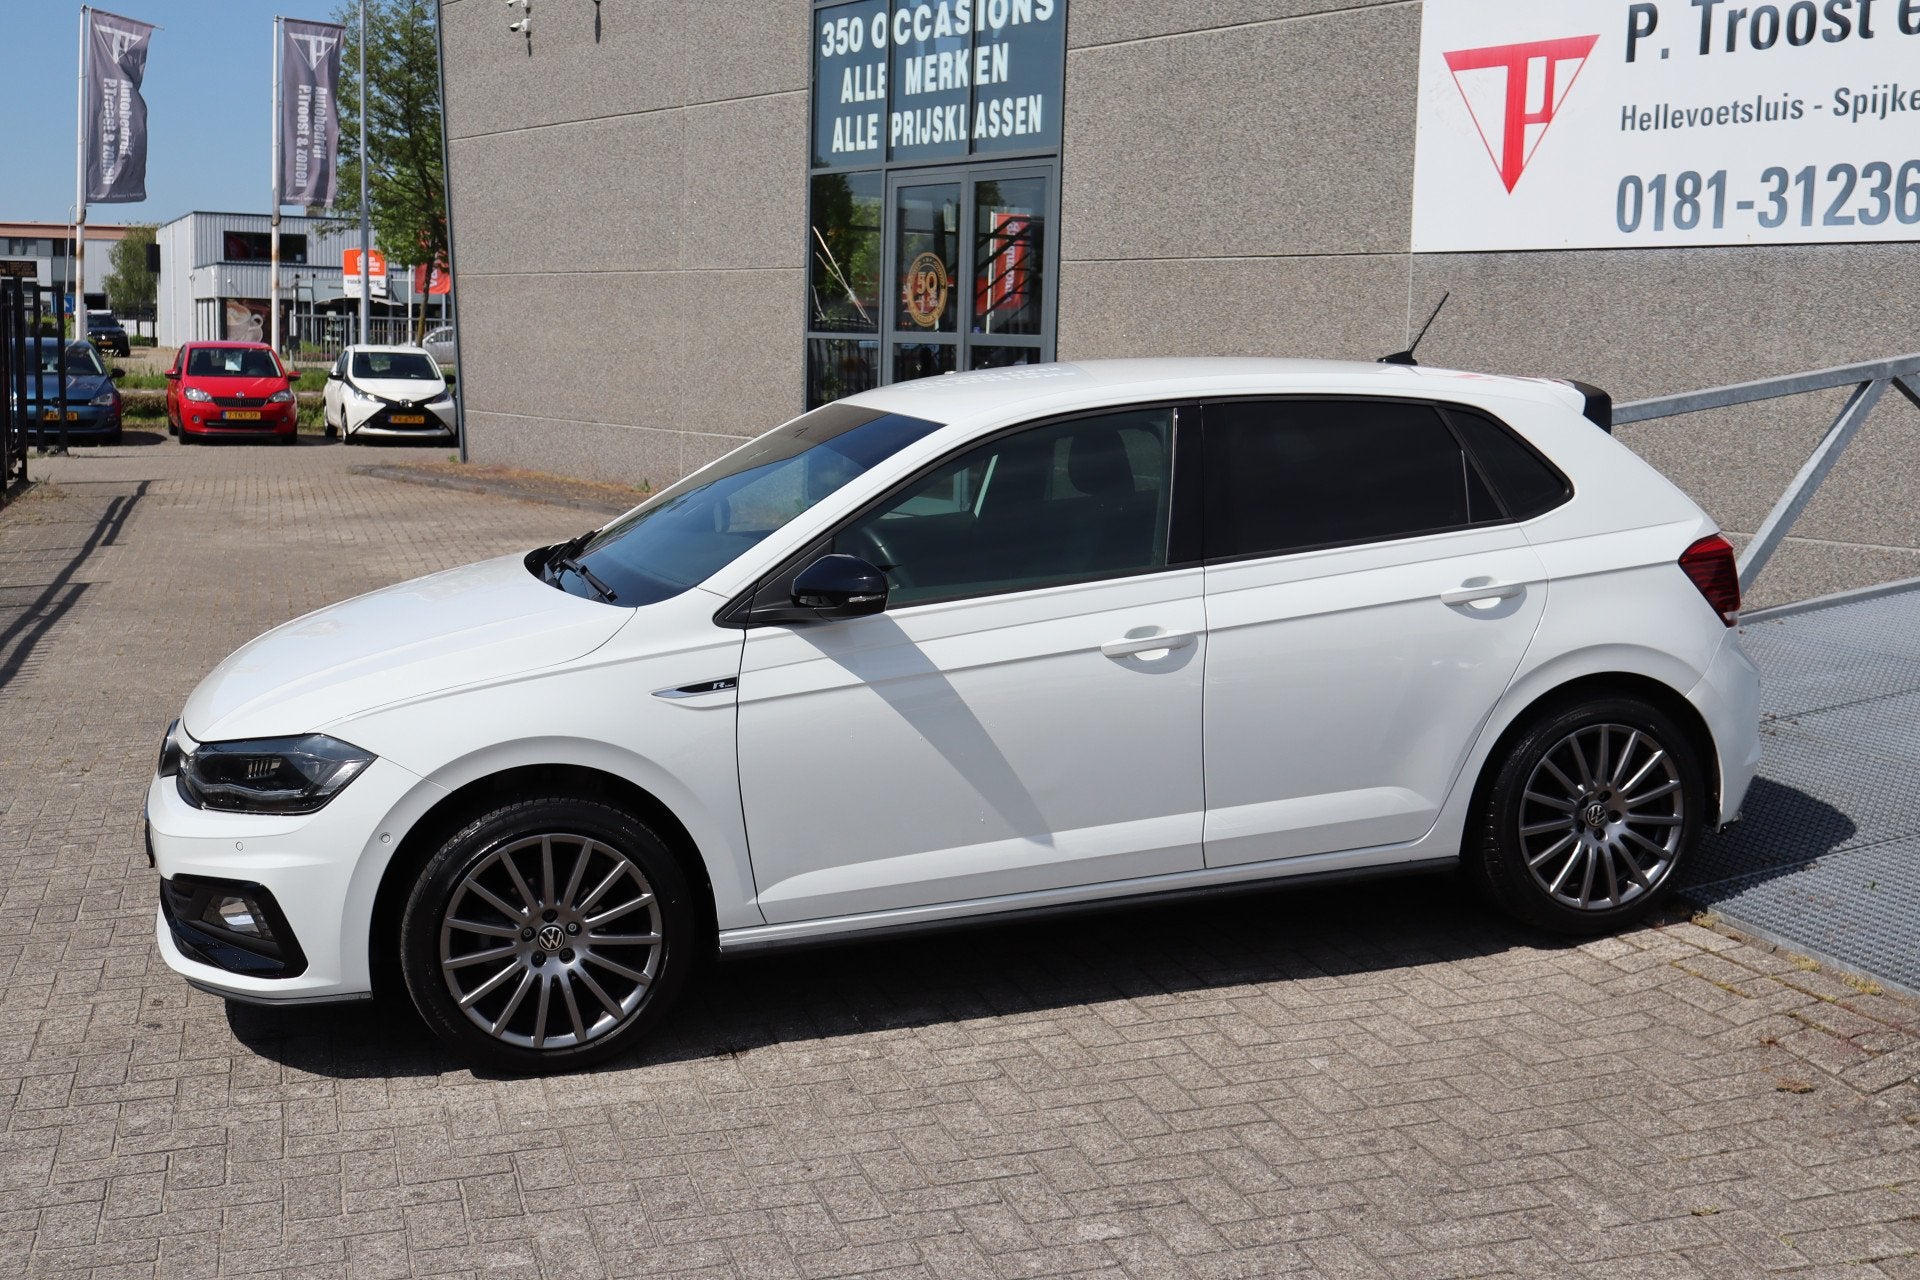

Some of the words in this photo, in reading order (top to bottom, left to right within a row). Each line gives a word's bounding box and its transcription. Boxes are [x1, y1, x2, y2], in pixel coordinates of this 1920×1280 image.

[821, 17, 864, 58] 350
[871, 0, 1054, 49] OCCASIONS
[1625, 2, 1670, 63] P.
[1691, 0, 1875, 56] Troost
[840, 62, 886, 104] ALLE
[904, 42, 1009, 96] MERKEN
[313, 86, 328, 160] Autobedrijf
[831, 113, 879, 153] ALLE
[890, 94, 1043, 148] PRIJSKLASSEN
[1621, 92, 1804, 132] Hellevoetsluis
[295, 149, 308, 188] zonen
[297, 137, 308, 147] &
[1614, 159, 1920, 234] 0181-31236
[916, 271, 938, 296] 50
